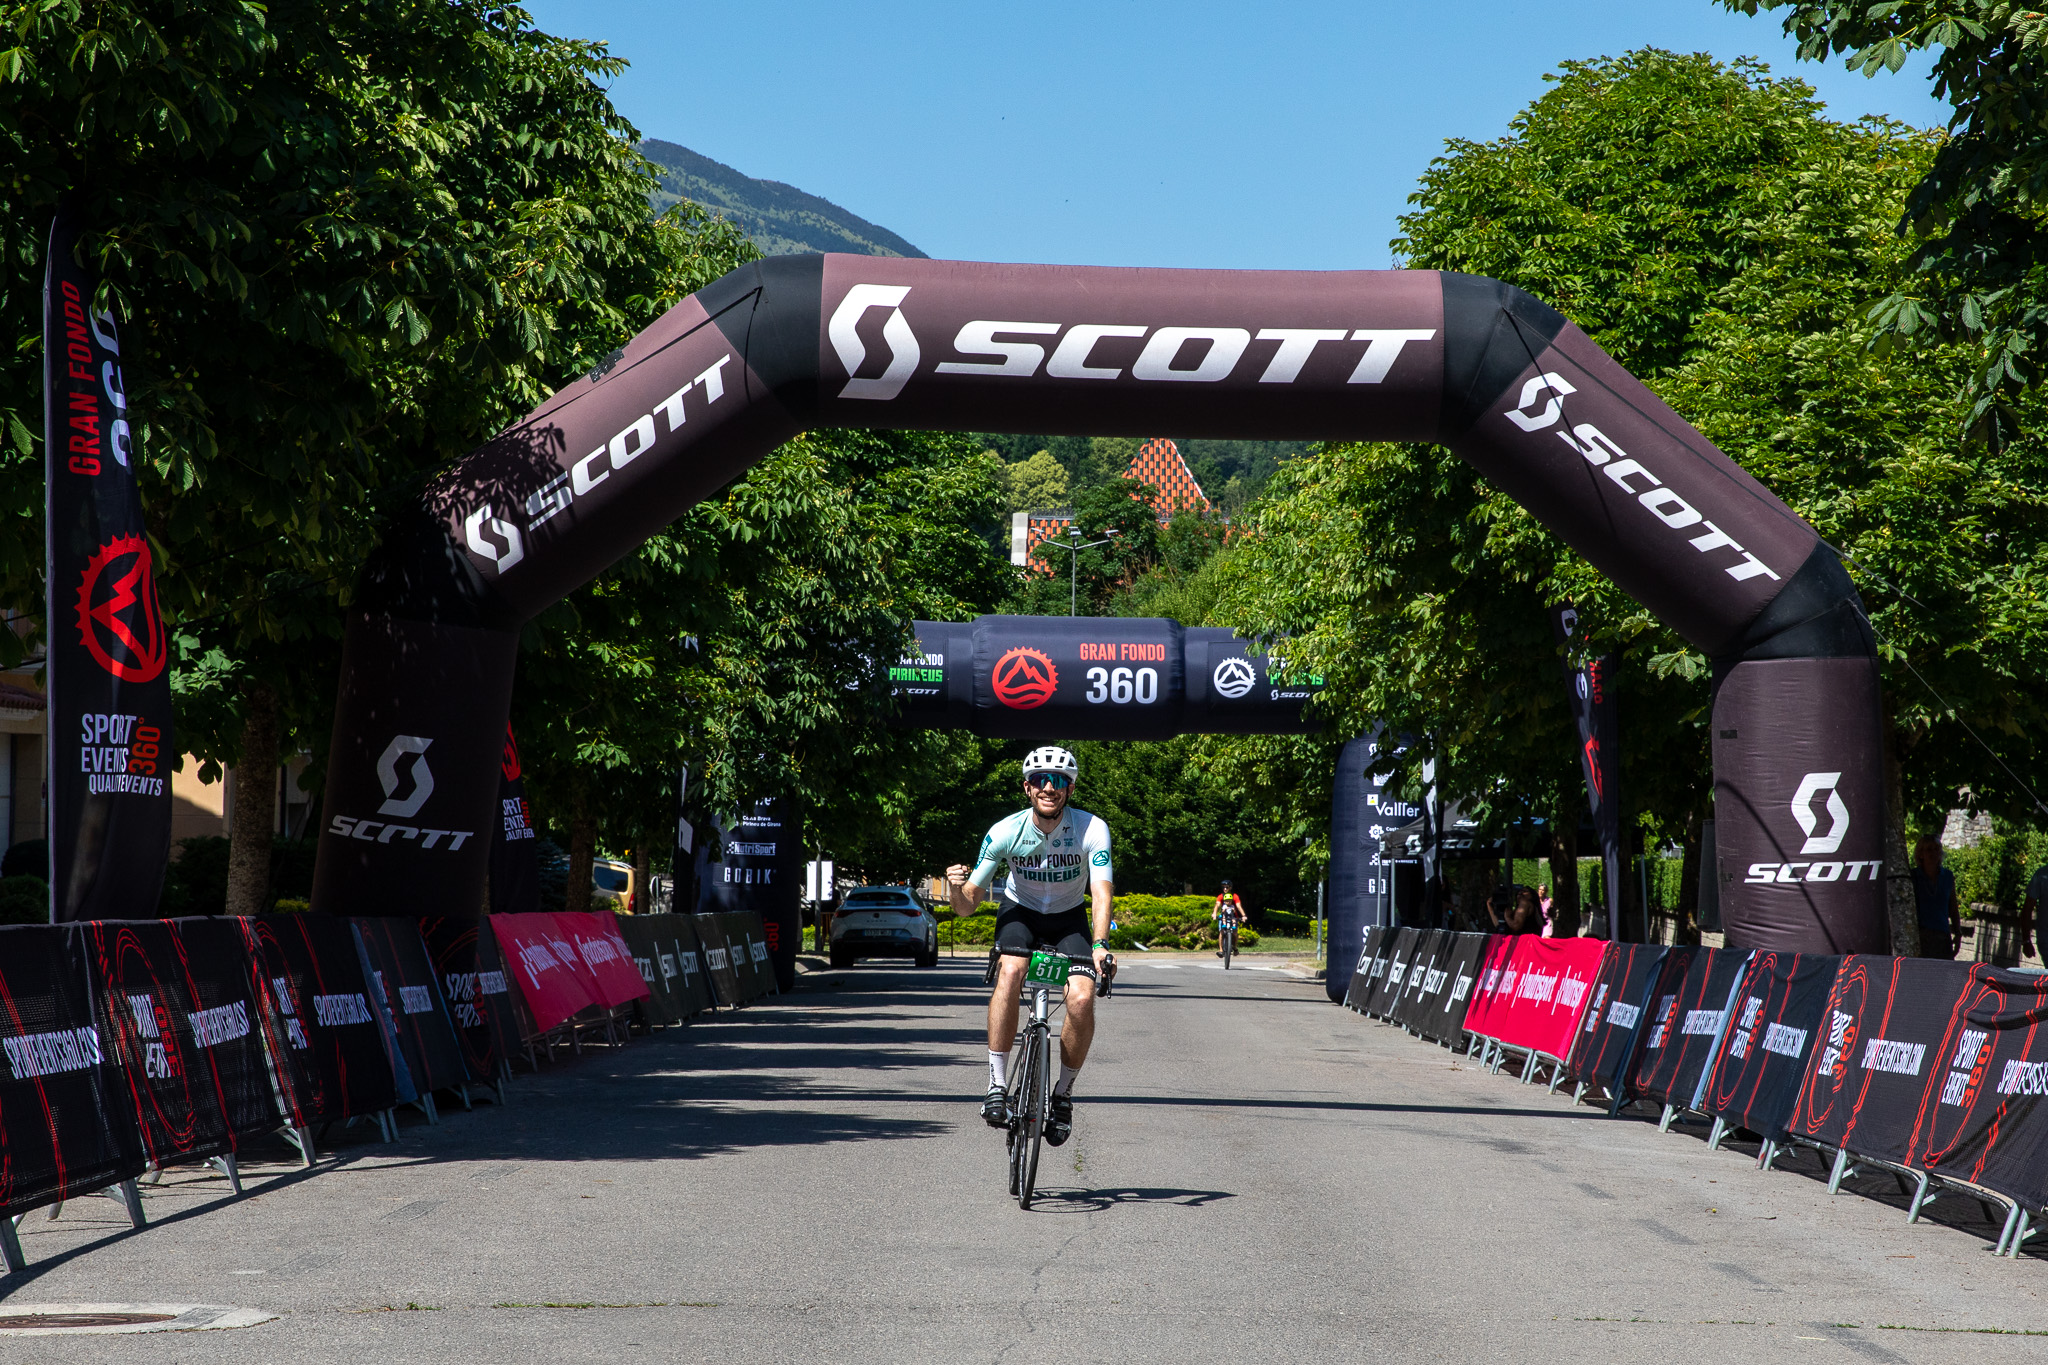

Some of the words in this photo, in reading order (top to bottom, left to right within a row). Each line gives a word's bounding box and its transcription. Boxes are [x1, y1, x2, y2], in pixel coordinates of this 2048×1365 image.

[61, 280, 96, 382] FONDO
[934, 320, 1437, 384] SCOTT
[69, 392, 102, 476] GRAN
[526, 353, 731, 532] SCOTT
[1555, 423, 1782, 582] SCOTT
[1080, 643, 1118, 661] GRAN
[1121, 643, 1165, 662] FONDO
[1086, 667, 1158, 705] 360
[81, 713, 137, 744] SPORT
[328, 814, 474, 851] SCOTT
[724, 867, 772, 884] GOBIK
[1011, 854, 1042, 868] GRAN
[1047, 853, 1082, 868] FONDO
[1744, 860, 1883, 883] SCOTT
[1036, 963, 1062, 980] 511
[1953, 1029, 1988, 1070] SPORT
